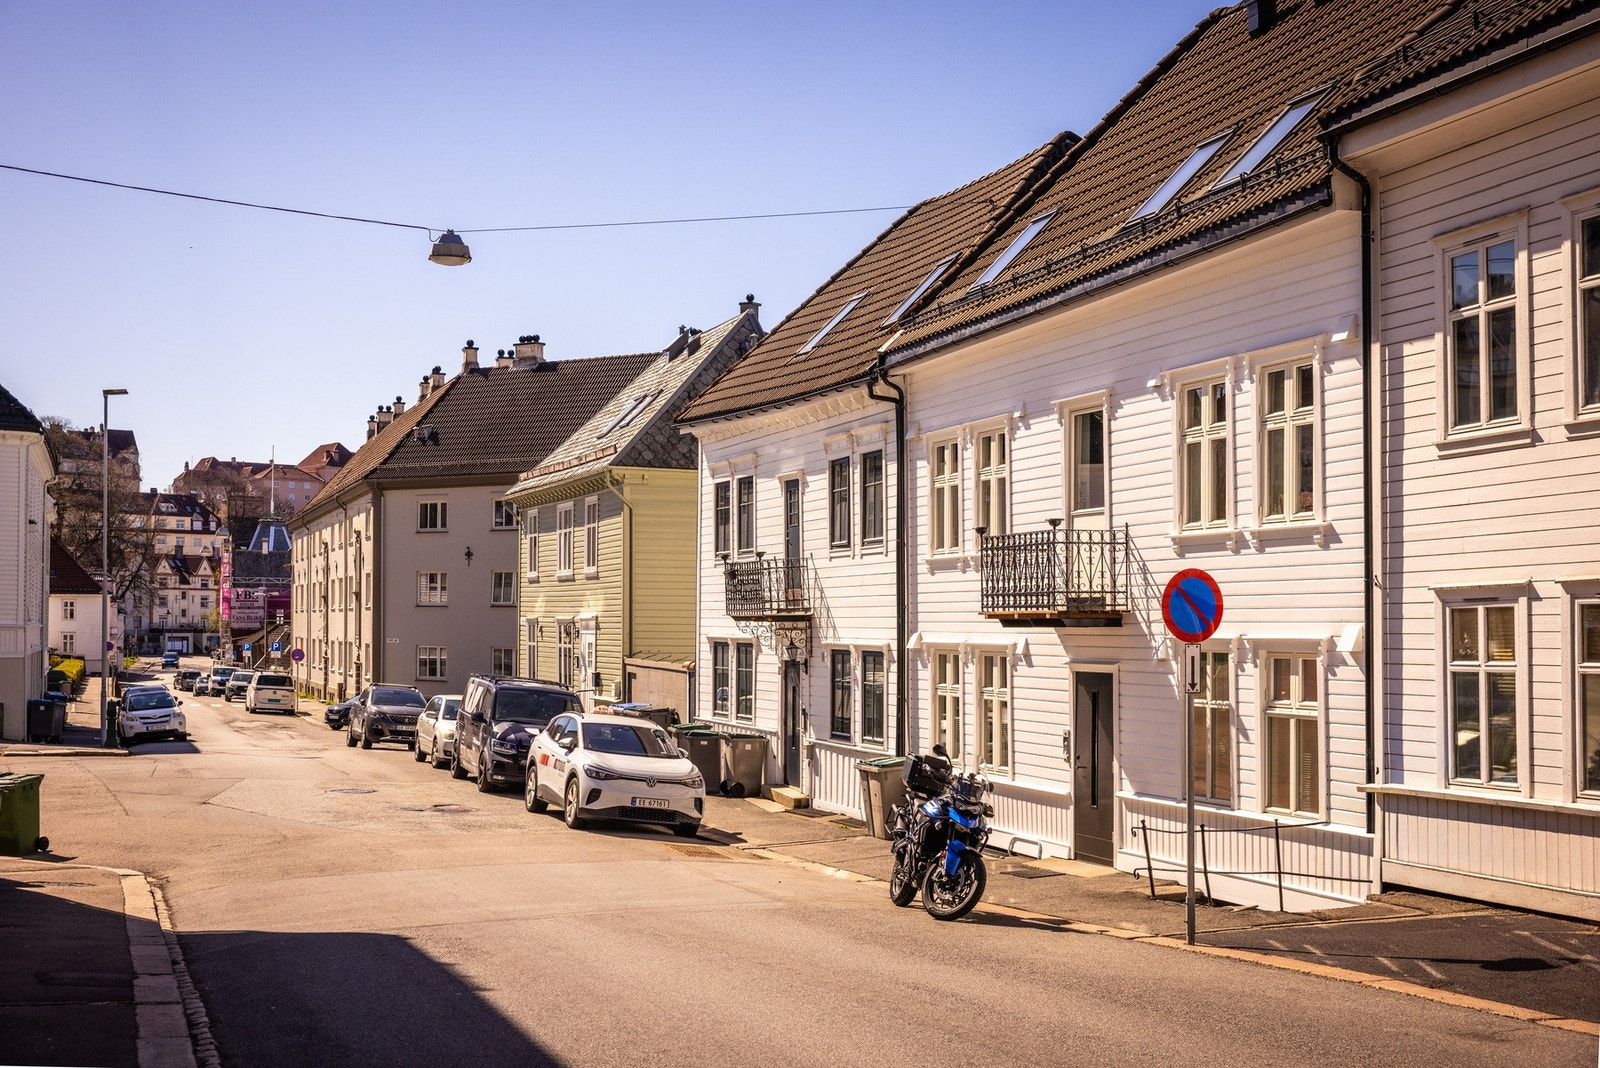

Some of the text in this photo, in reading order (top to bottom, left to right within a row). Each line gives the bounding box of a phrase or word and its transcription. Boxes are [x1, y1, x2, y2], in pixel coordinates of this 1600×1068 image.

[273, 642, 279, 650] P
[638, 798, 666, 808] EE 67161
